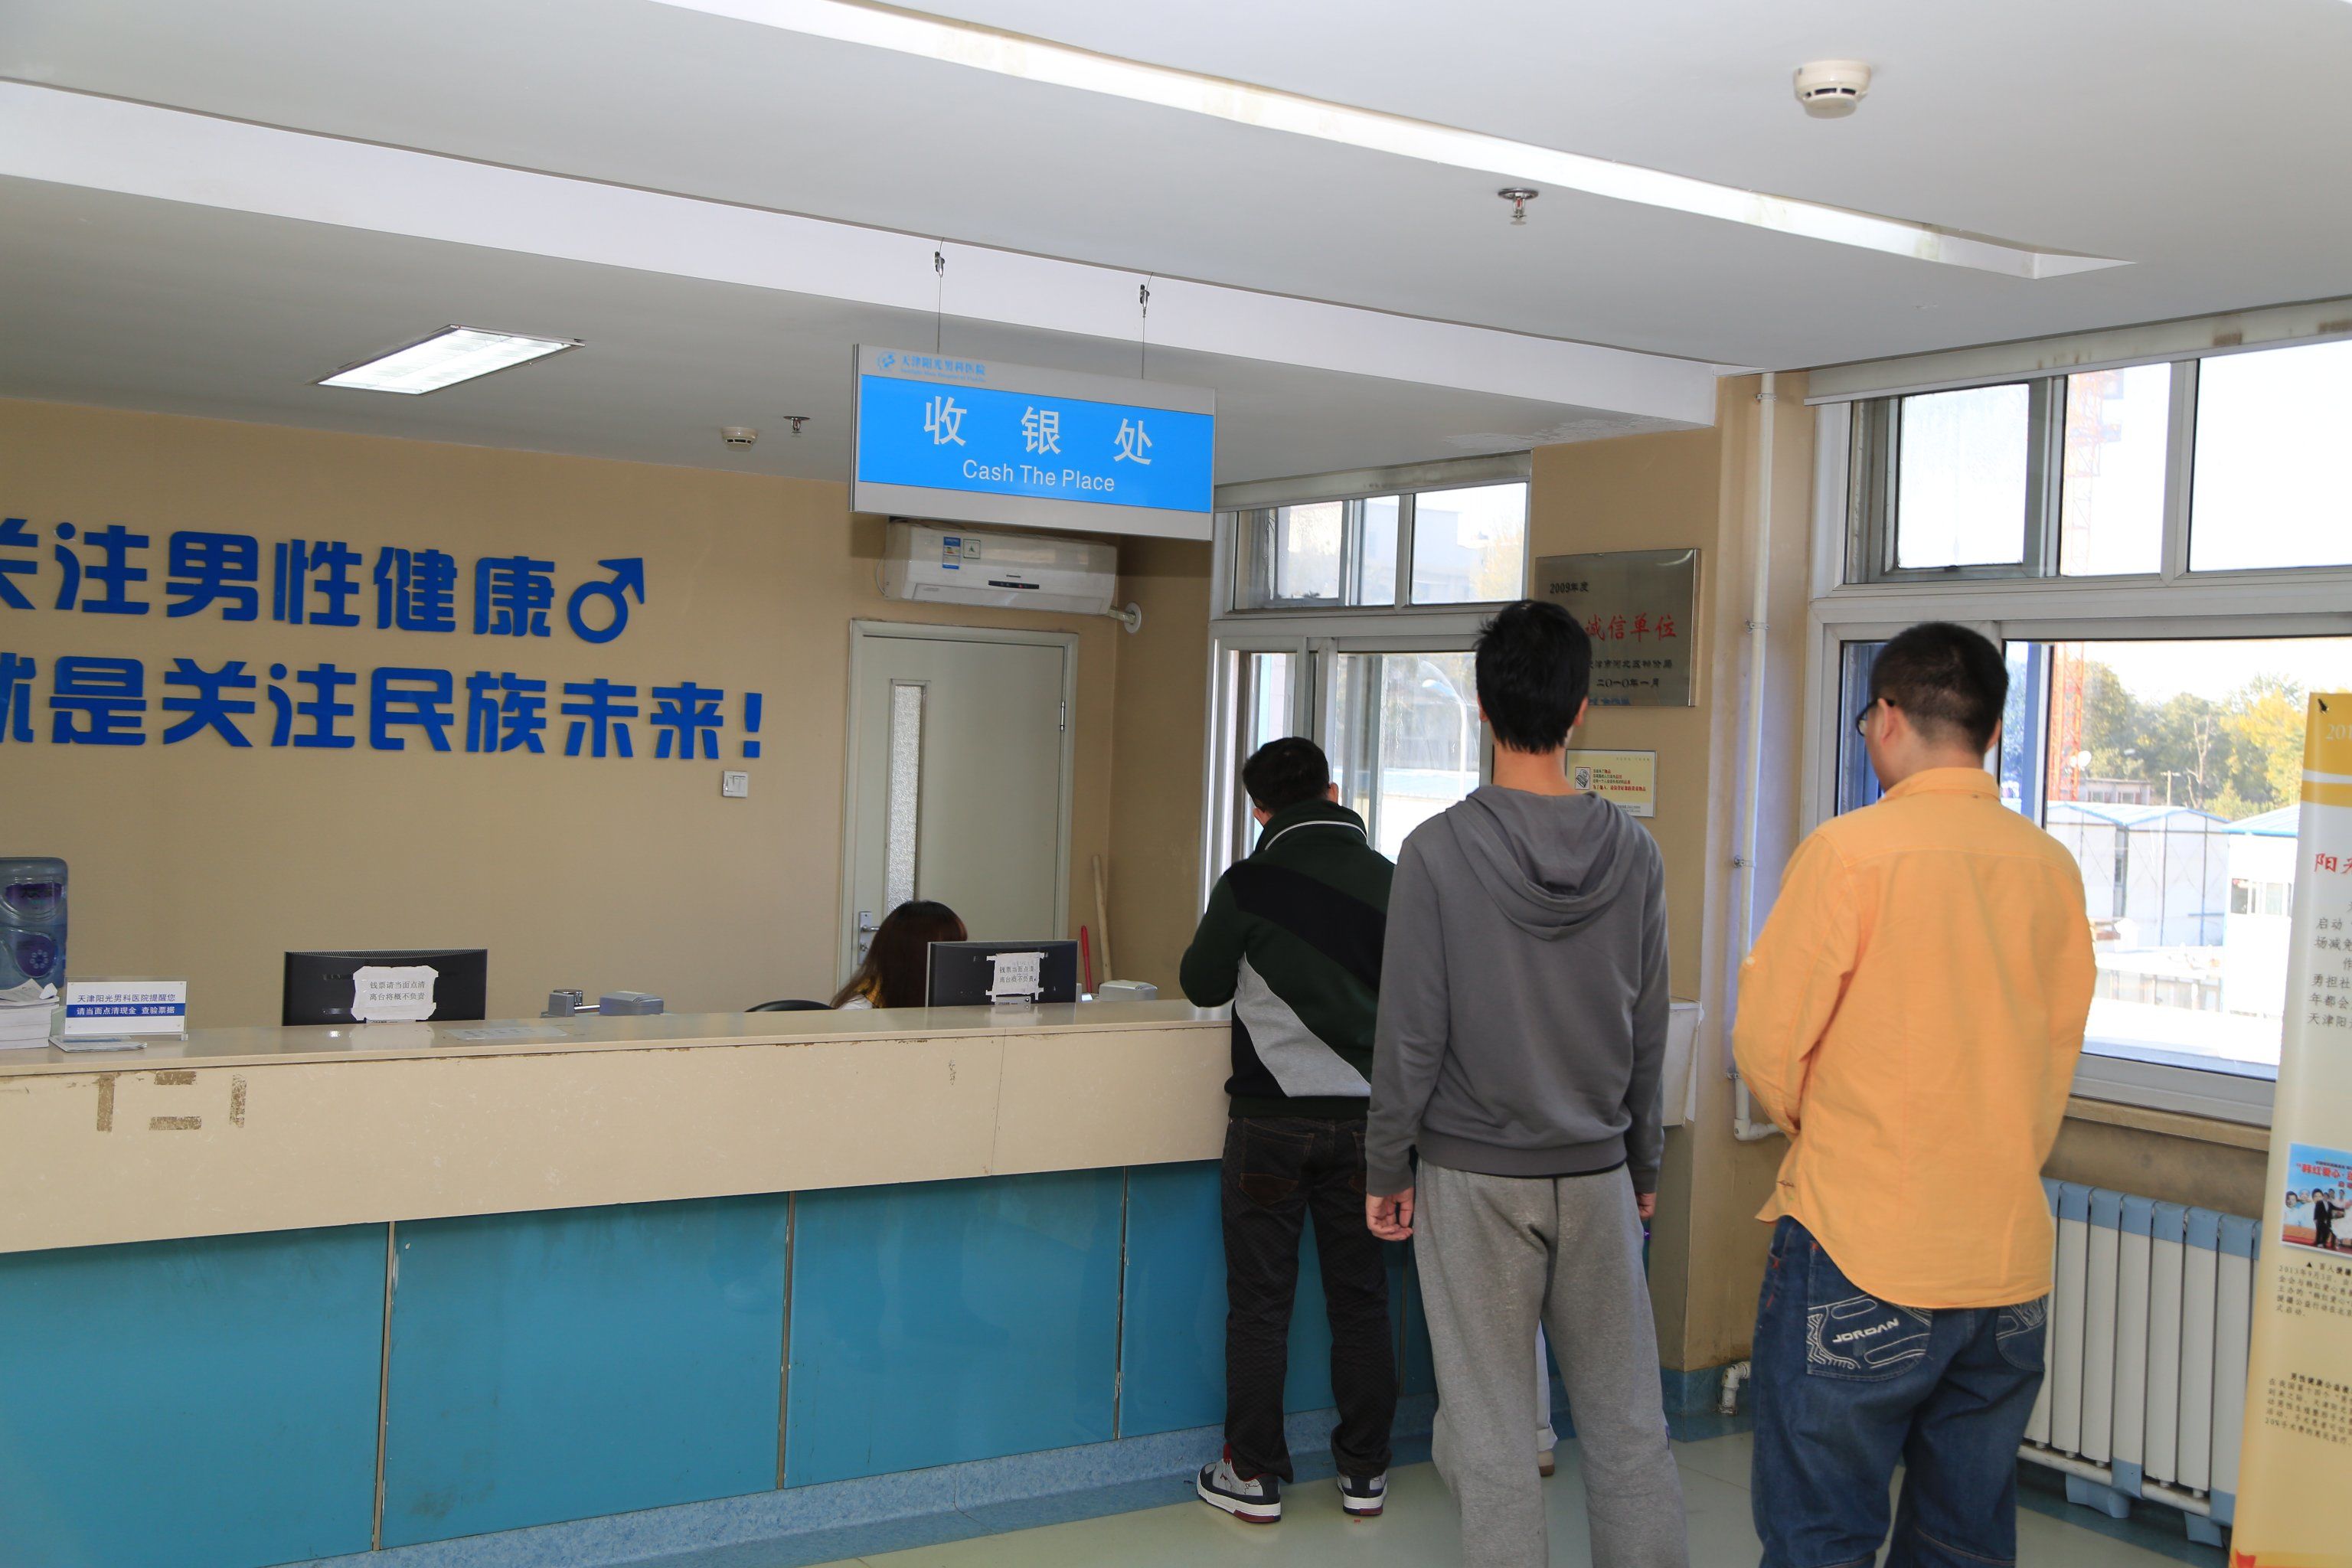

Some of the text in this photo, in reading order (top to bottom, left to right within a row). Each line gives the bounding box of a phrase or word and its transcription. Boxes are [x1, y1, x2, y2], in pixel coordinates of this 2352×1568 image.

[923, 396, 1152, 465] 收银处
[962, 459, 1116, 492] Cash The Place
[1550, 581, 1589, 594] 2009年度
[1585, 612, 1677, 642] 诚信单位
[369, 981, 426, 989] 钱票请当面点清
[77, 993, 176, 1003] 天津阳光男科医院提醒您
[369, 992, 426, 1001] 离台将概不负责
[77, 1006, 175, 1016] 请当面点清现金 查验票据
[2308, 1013, 2352, 1029] 天津阳
[1832, 1318, 1900, 1343] JORDAN
